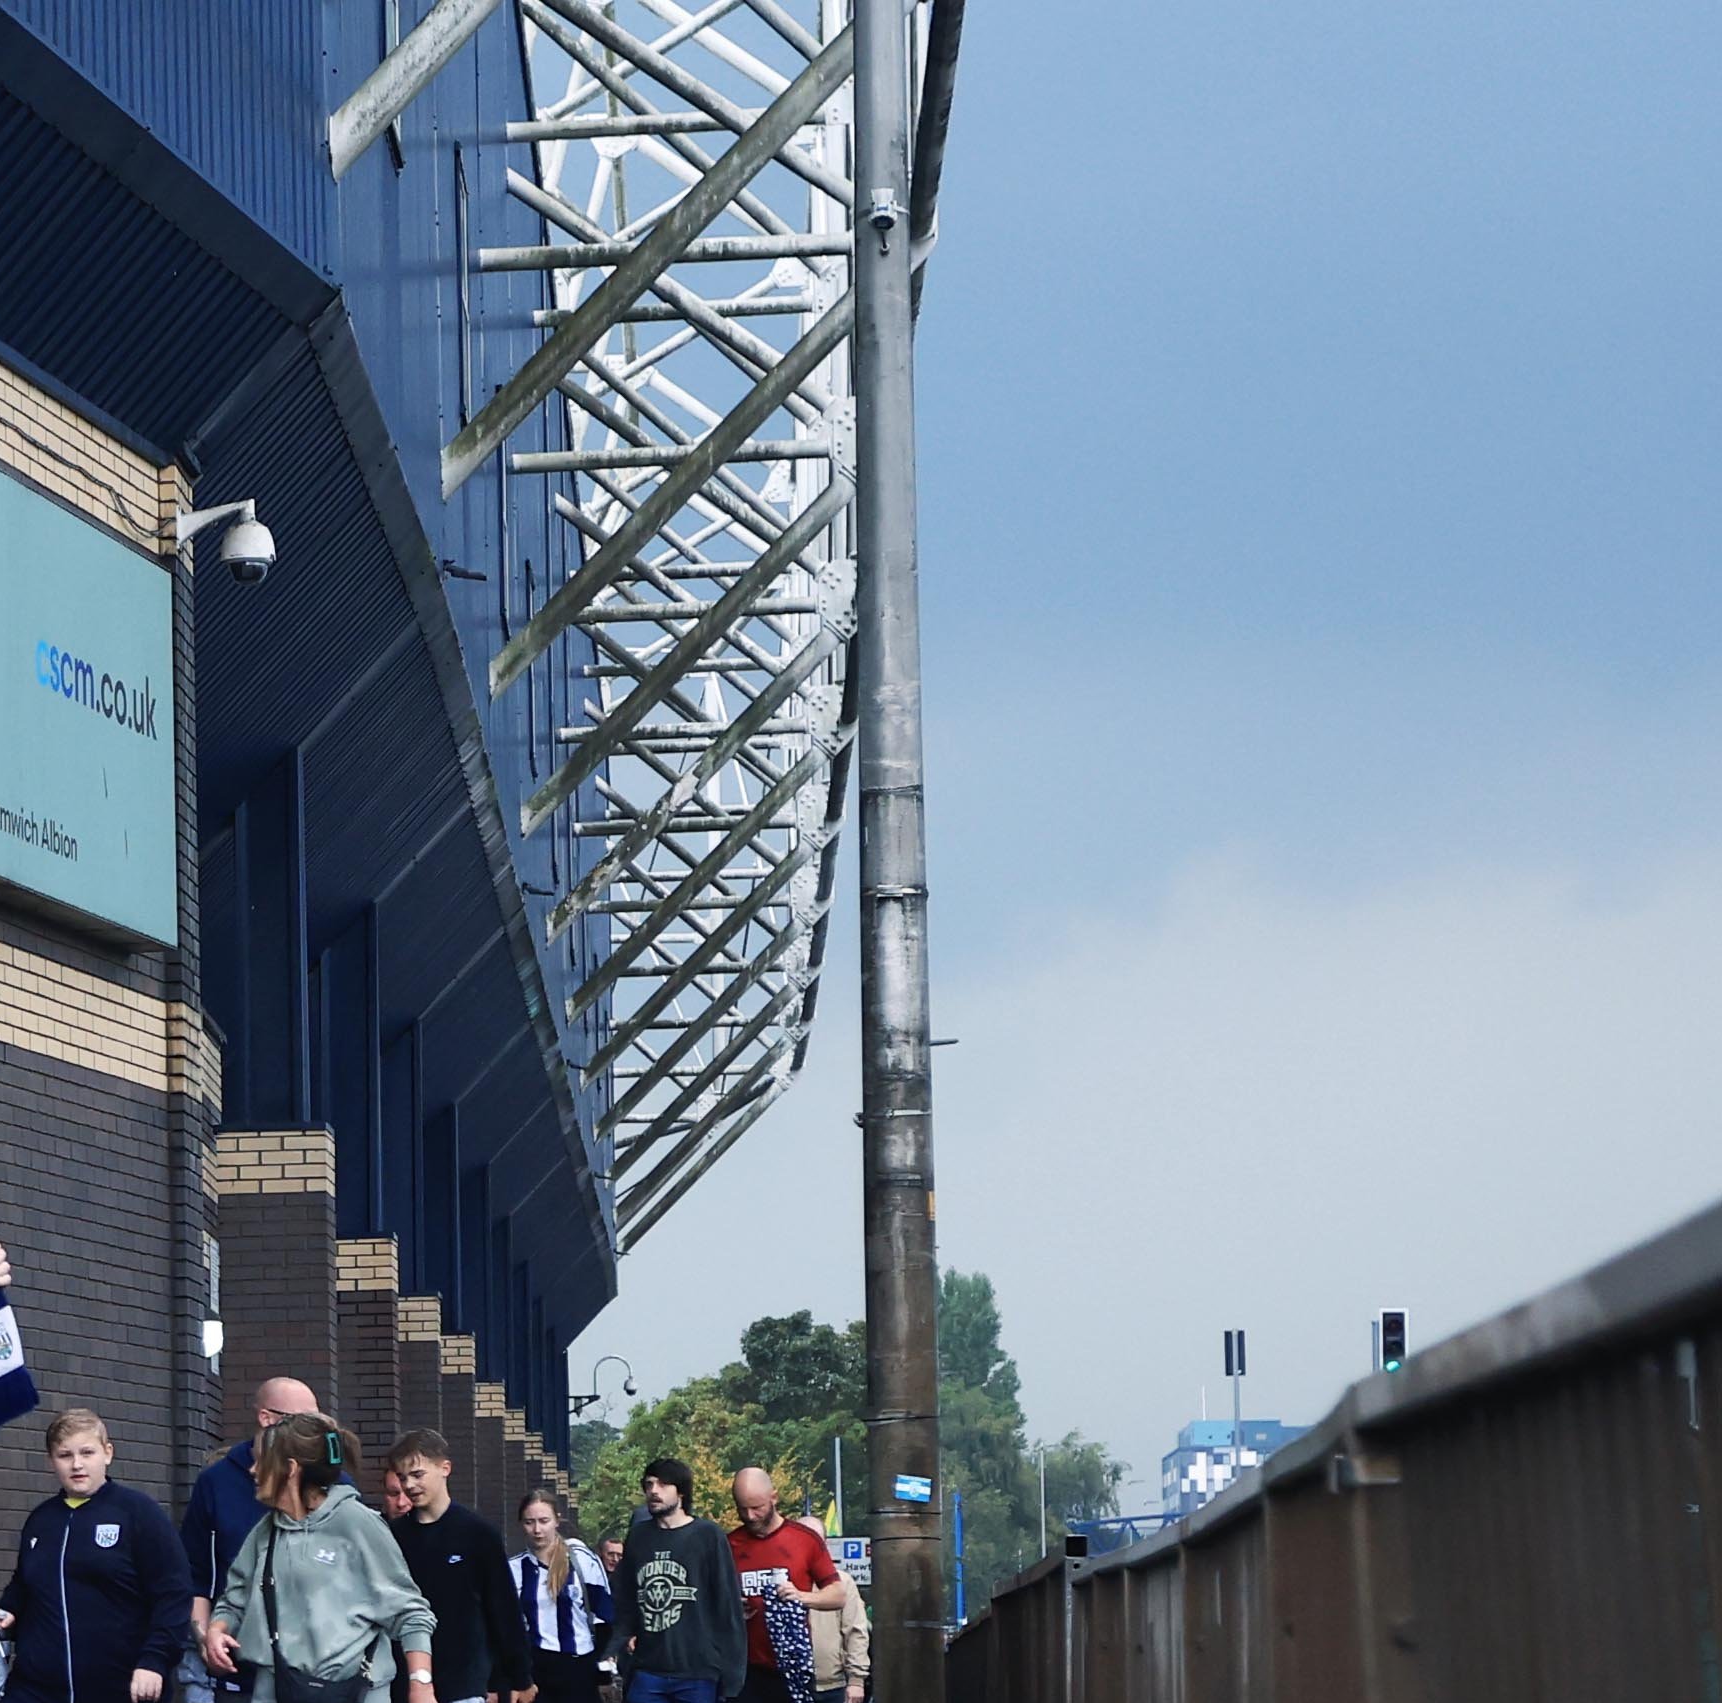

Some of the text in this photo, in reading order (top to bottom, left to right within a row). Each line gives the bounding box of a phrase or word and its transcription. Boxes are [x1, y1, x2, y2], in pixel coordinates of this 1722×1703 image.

[35, 638, 158, 741] cscm.co.uk
[41, 818, 79, 863] Albion
[655, 1551, 672, 1560] THE
[846, 1563, 872, 1571] Hawt
[637, 1559, 688, 1586] WONDER
